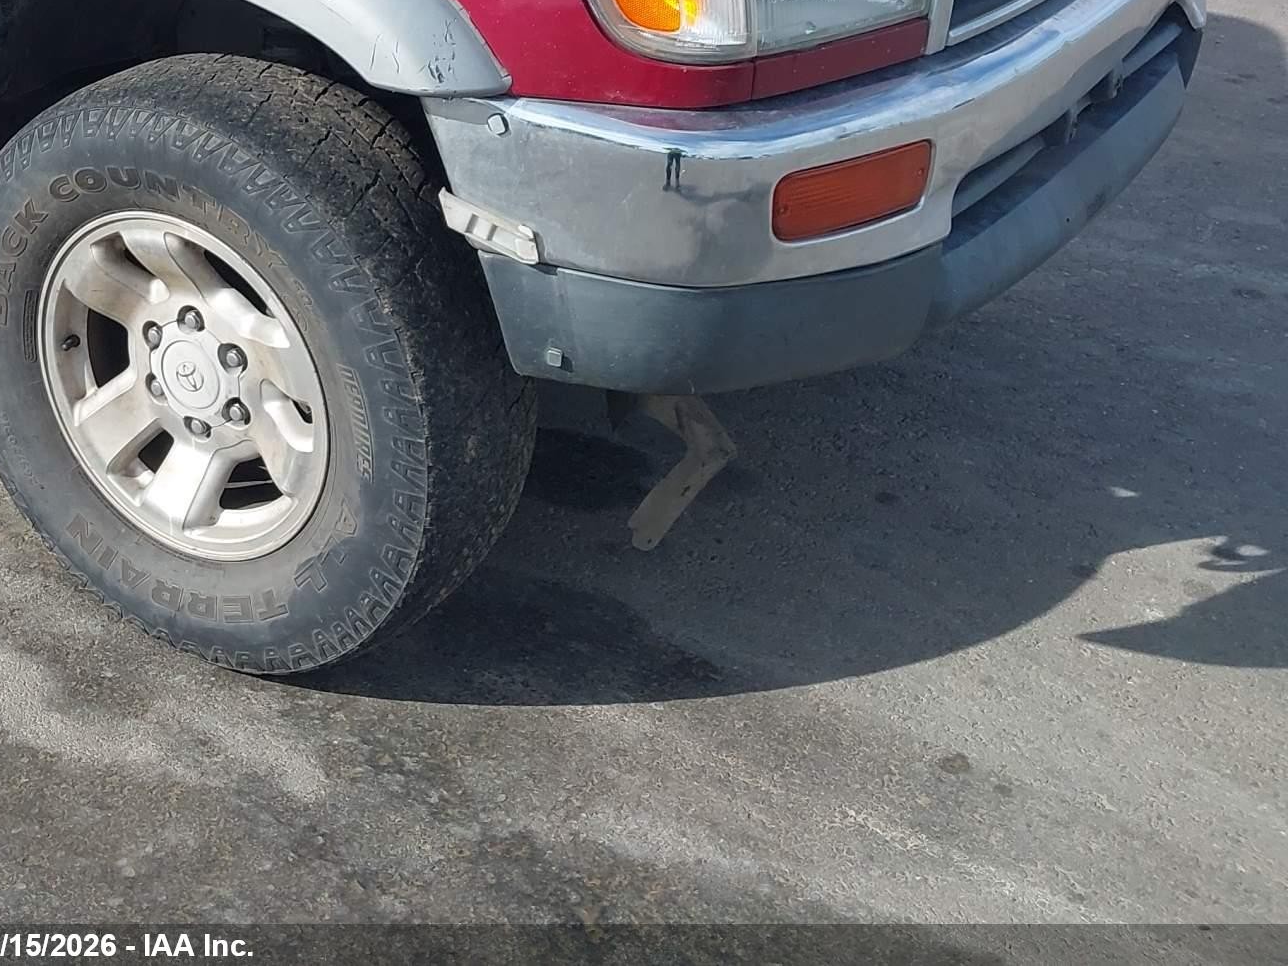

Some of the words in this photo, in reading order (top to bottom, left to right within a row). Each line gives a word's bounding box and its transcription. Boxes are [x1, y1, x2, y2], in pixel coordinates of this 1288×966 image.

[48, 166, 289, 267] COUNTRY
[66, 513, 289, 624] TERRAIN
[294, 501, 358, 594] ALL
